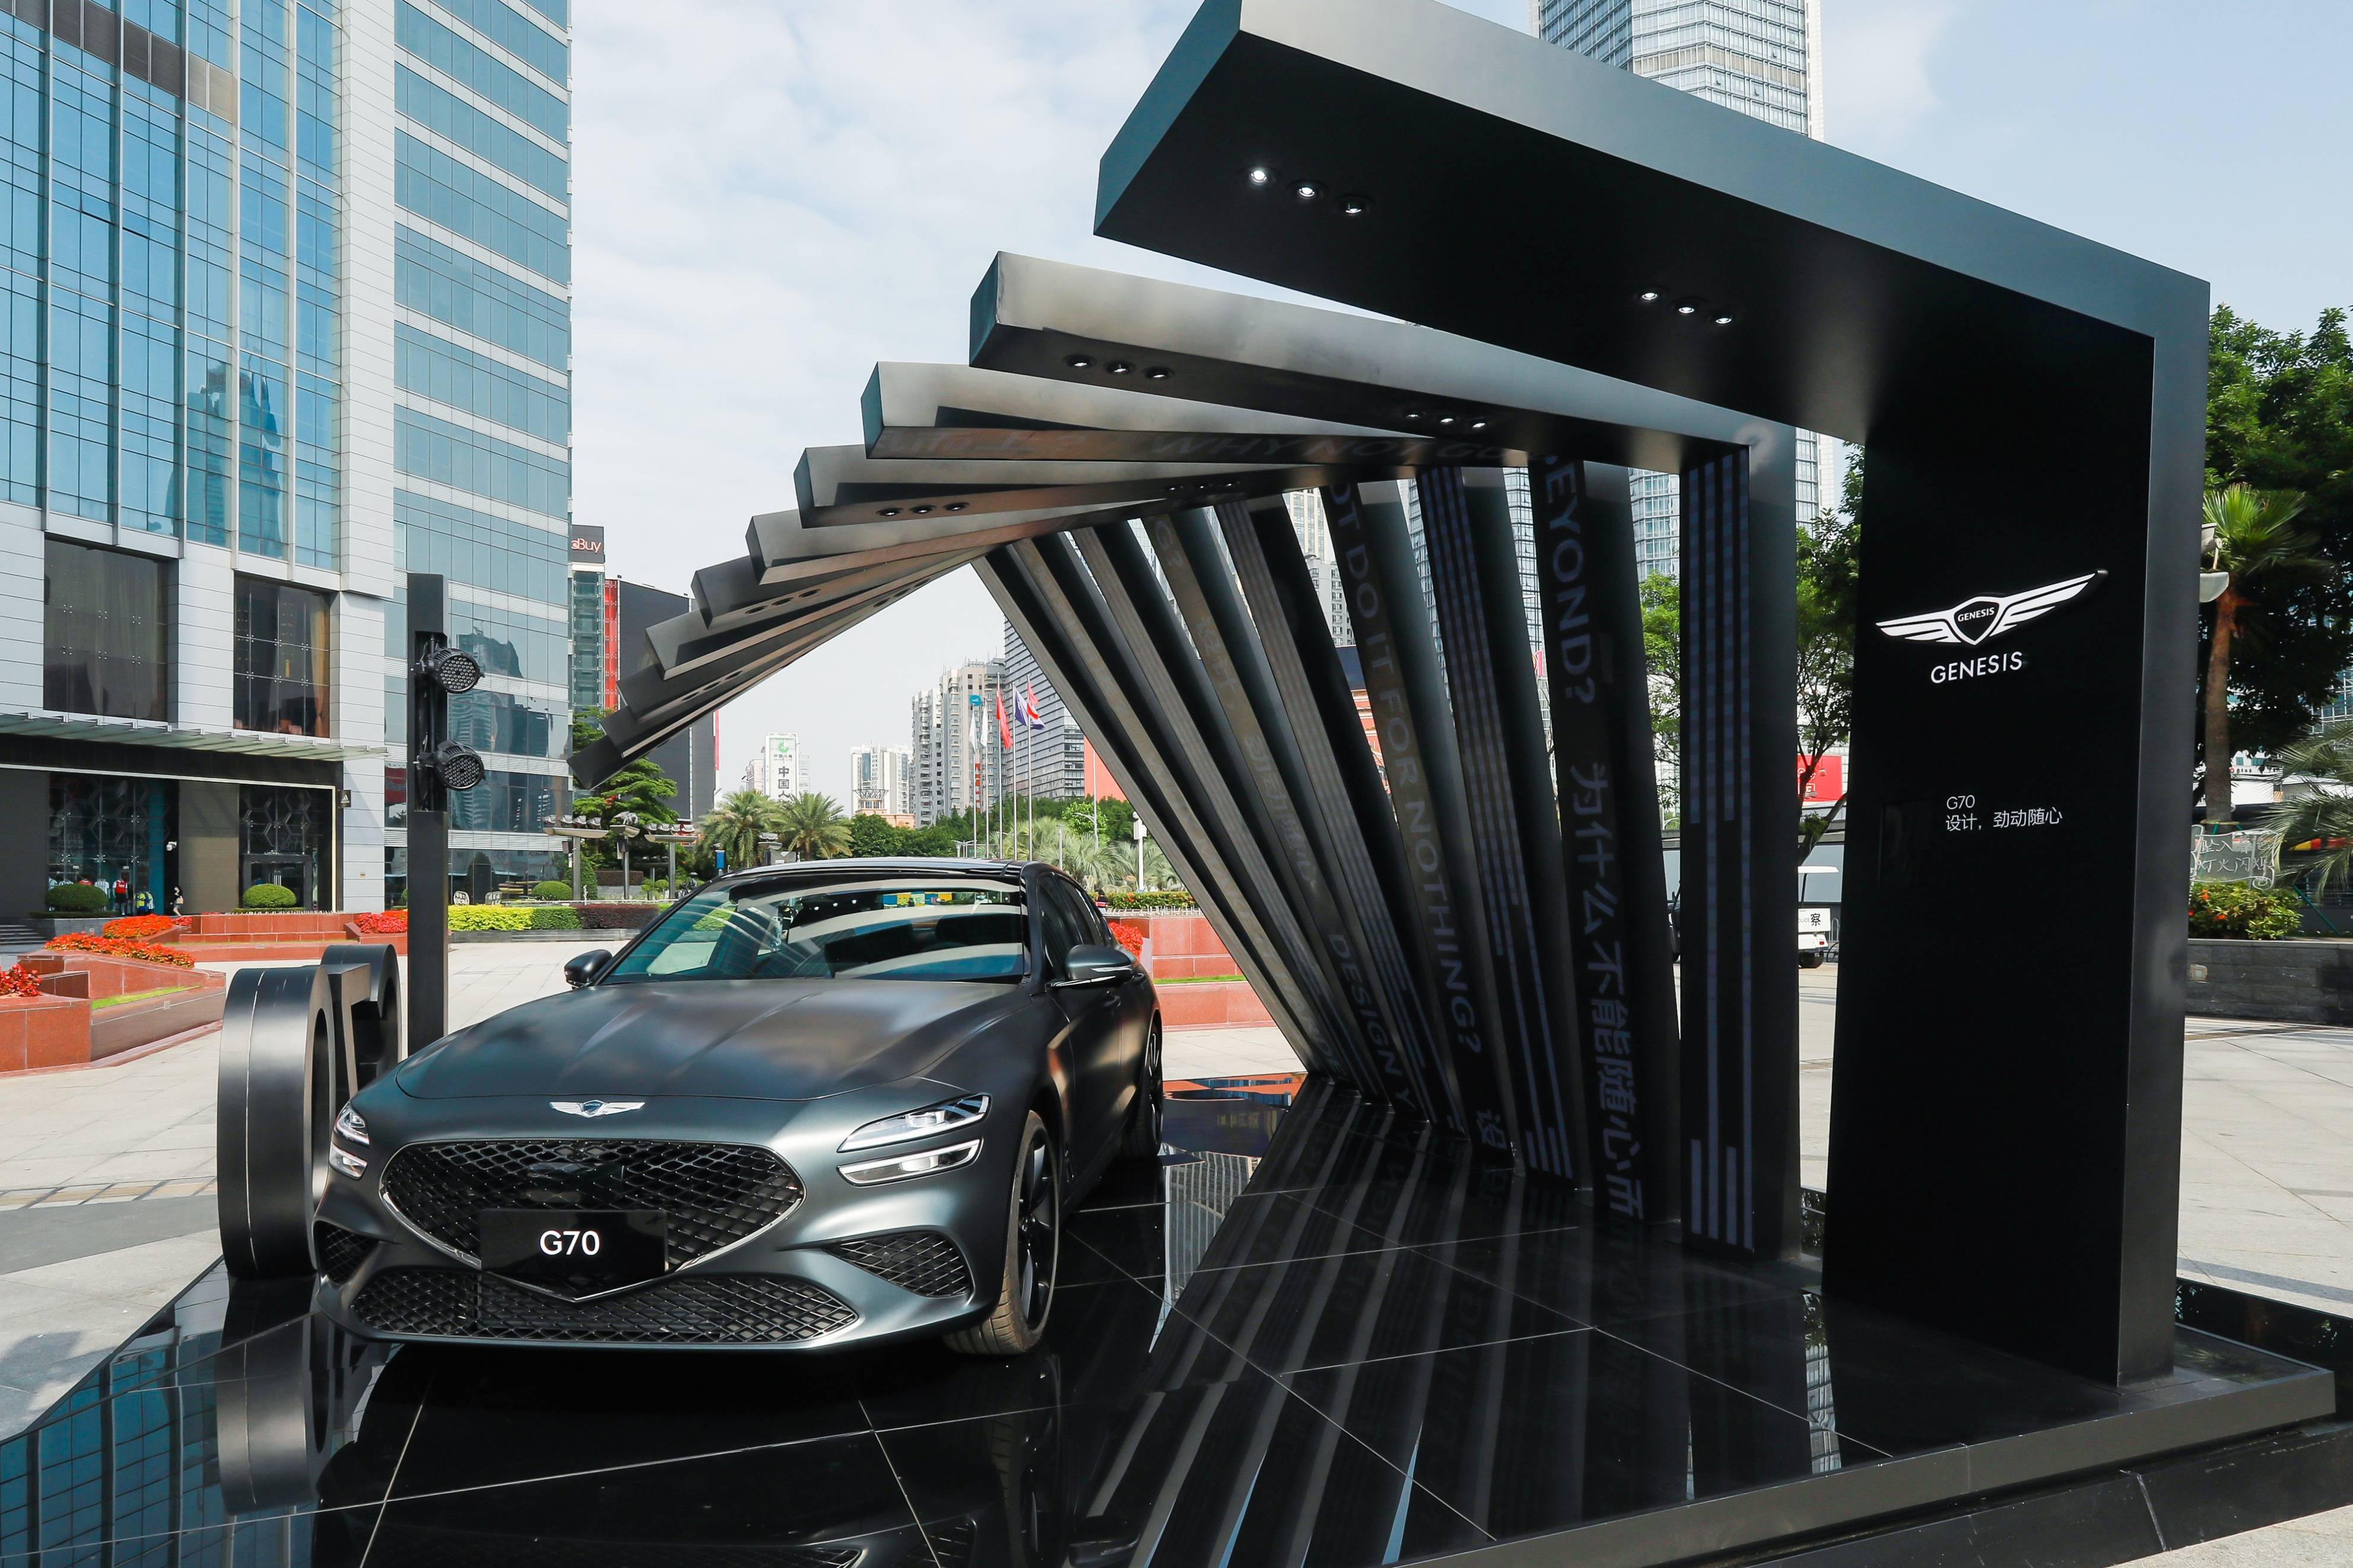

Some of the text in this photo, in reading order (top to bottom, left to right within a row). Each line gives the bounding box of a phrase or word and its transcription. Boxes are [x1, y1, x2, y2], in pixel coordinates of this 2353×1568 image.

[1152, 435, 1302, 456] WHY
[1306, 437, 1427, 458] NOT
[1544, 456, 1596, 705] EYOND?
[1957, 606, 1995, 622] GENESIS
[1930, 651, 2023, 684] GENESIS
[1329, 484, 1482, 1054] OT DO IT FOR NOTHING?
[1946, 794, 1976, 810] G70
[1945, 806, 2063, 832] 设计，劲动随心
[1811, 912, 1821, 927] 察
[1327, 933, 1406, 1077] DESIGN
[1476, 1109, 1508, 1150] 设
[539, 1229, 601, 1257] G70
